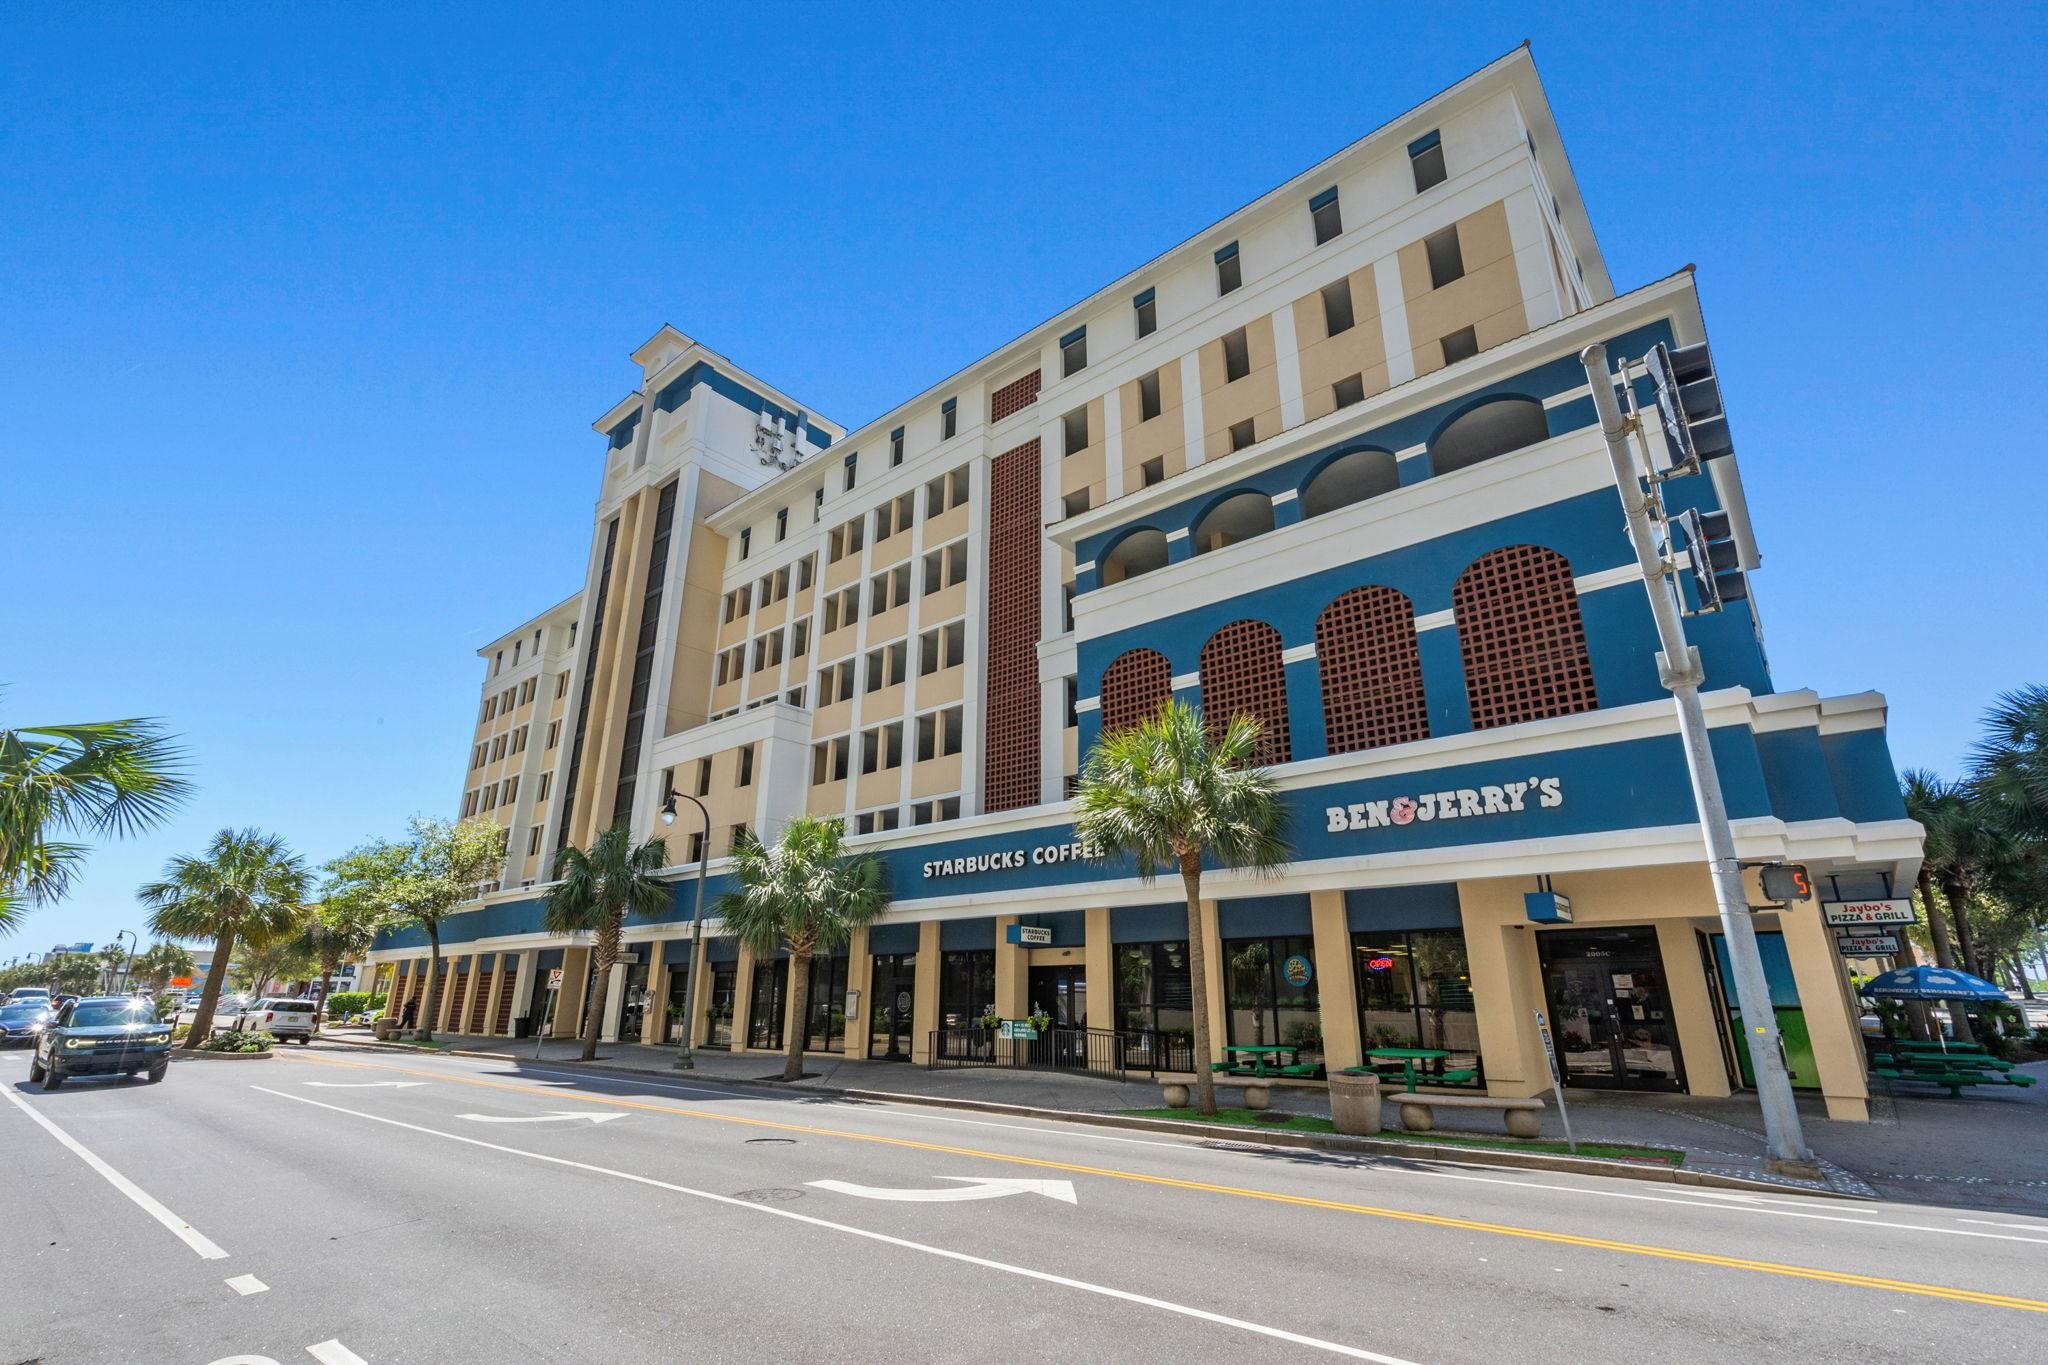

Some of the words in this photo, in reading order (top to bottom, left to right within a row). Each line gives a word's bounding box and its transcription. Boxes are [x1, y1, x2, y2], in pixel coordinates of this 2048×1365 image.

[923, 850, 1025, 878] STARBUCKS
[1792, 872, 1808, 895] 5
[1842, 902, 1892, 914] Jaybo's
[1831, 914, 1863, 922] PIZZA
[1865, 913, 1873, 921] &
[1875, 911, 1909, 921] GRILL
[1021, 927, 1050, 936] STARBUCKS
[1027, 934, 1045, 942] COFFEE
[1850, 938, 1884, 946] Jaybo's
[1369, 959, 1393, 968] OPEN
